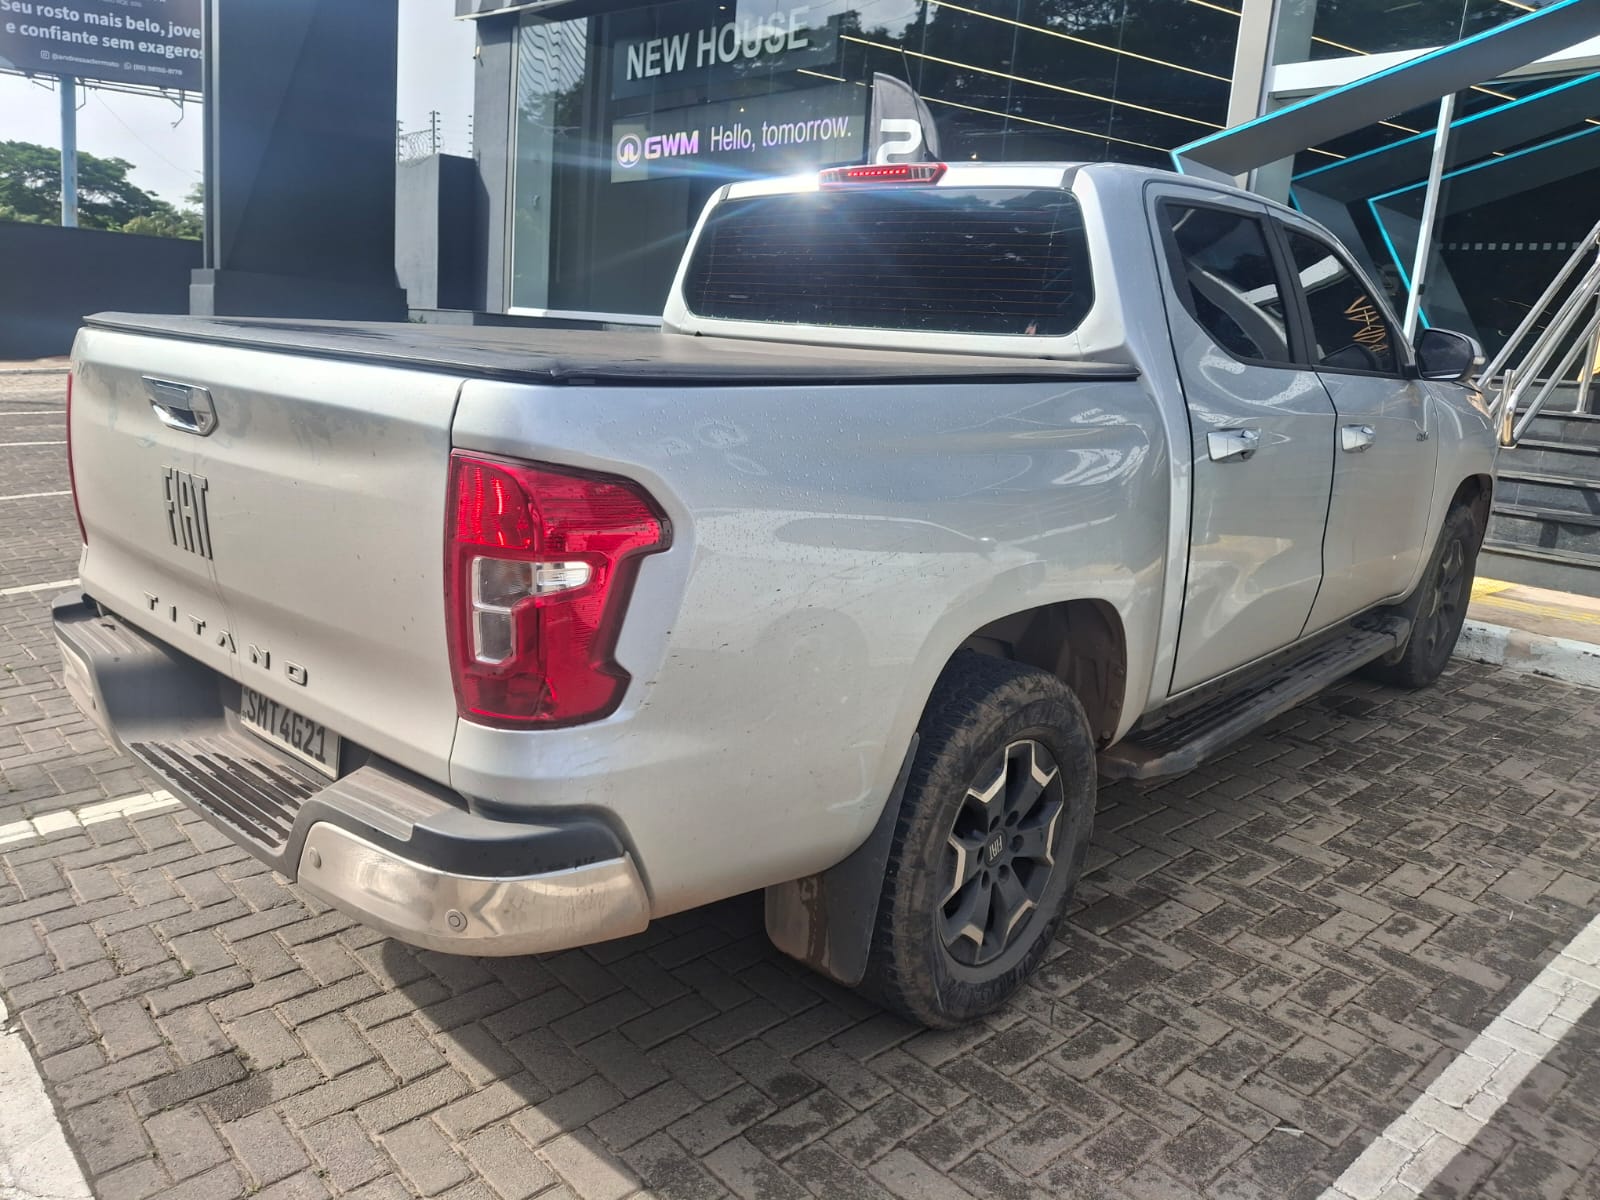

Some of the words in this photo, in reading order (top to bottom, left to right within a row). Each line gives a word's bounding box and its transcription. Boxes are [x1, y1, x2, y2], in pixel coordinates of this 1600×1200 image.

[1, 0, 32, 15] Seu
[36, 3, 80, 22] rosto
[83, 12, 123, 28] mais
[126, 15, 165, 37] belo,
[5, 22, 16, 33] e
[20, 24, 99, 46] confiante
[102, 36, 134, 51] sem
[626, 32, 690, 81] NEW
[696, 6, 810, 68] HOUSE
[644, 130, 699, 160] GWM
[710, 122, 756, 152] Hello,
[761, 115, 852, 147] tomorrow.
[160, 464, 213, 561] FIAT
[144, 590, 308, 687] TITANO
[247, 689, 327, 765] SMT4G21
